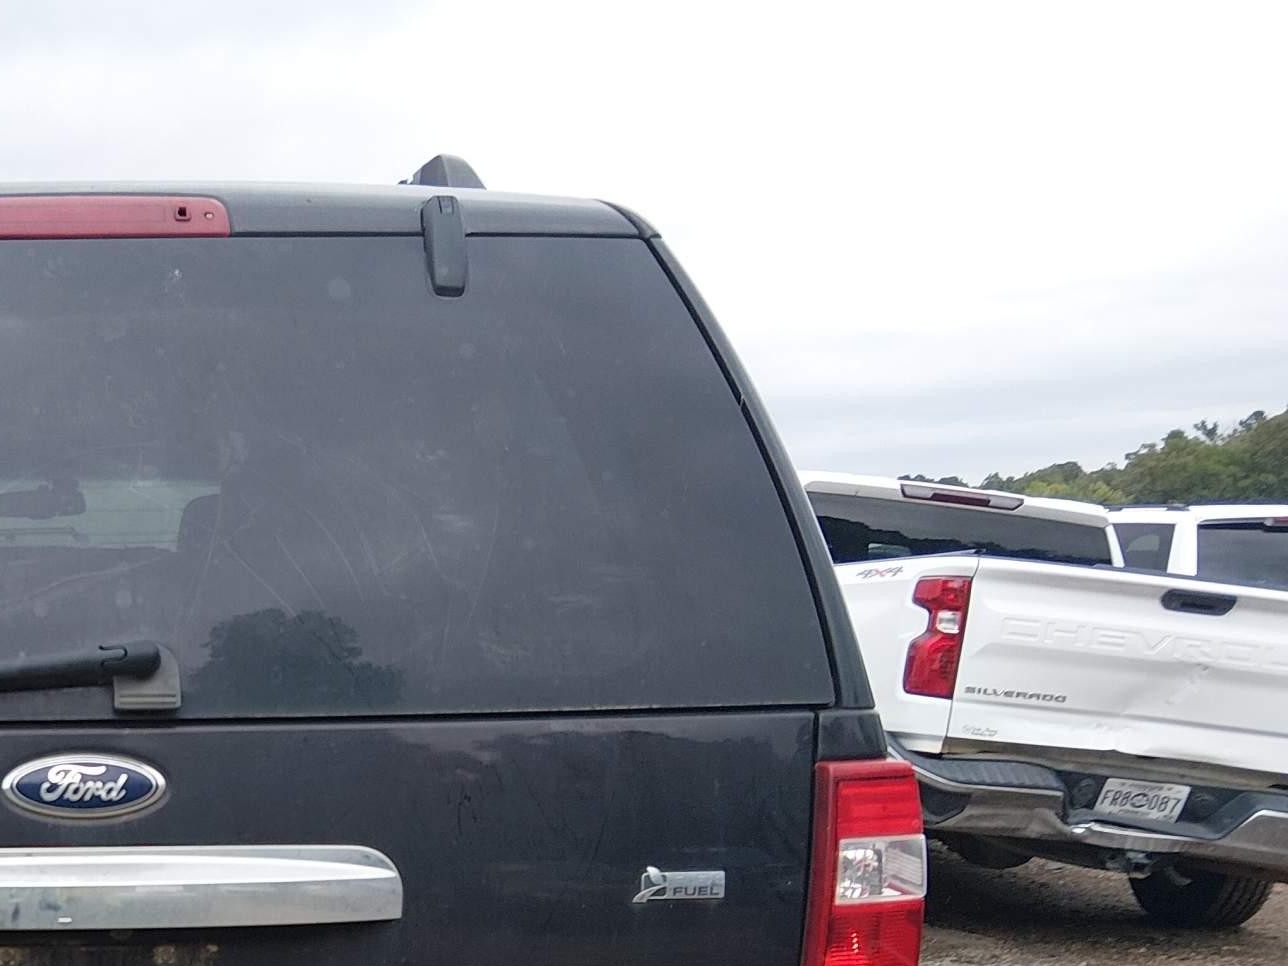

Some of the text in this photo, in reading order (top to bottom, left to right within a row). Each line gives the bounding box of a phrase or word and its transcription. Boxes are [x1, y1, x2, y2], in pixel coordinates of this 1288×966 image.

[964, 685, 1068, 704] SILVERADO
[39, 763, 129, 802] Ford
[672, 886, 721, 897] FUEL
